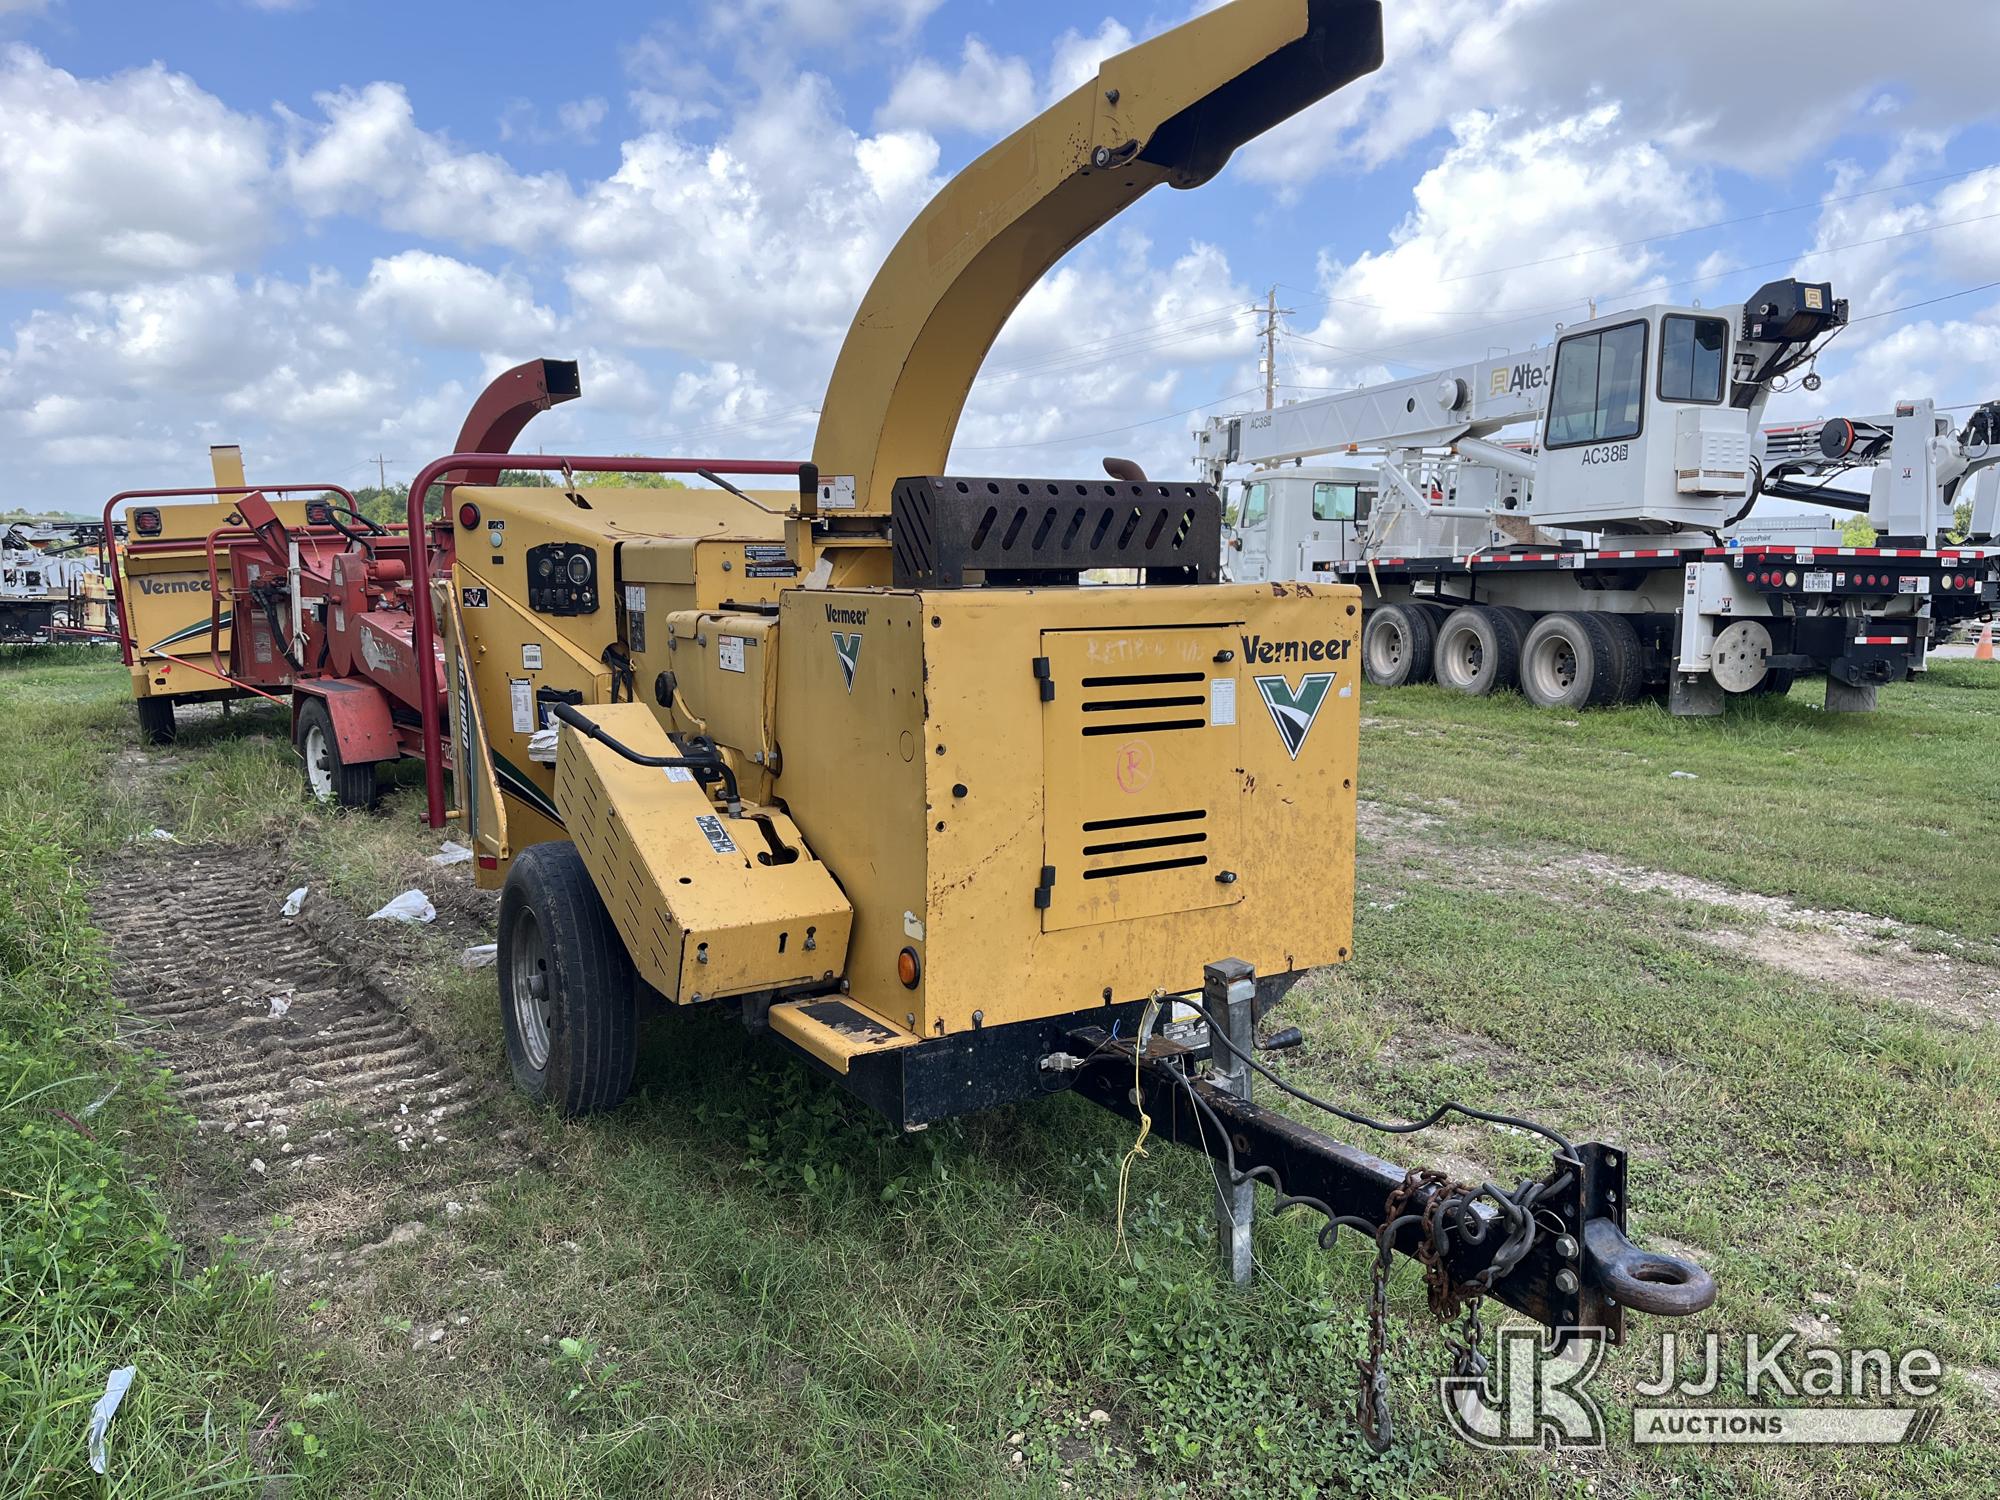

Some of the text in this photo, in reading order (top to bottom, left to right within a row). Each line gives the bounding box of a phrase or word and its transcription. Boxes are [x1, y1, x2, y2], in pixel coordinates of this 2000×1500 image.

[139, 579, 211, 595] Vermee
[825, 604, 867, 625] Vermeer
[1241, 635, 1351, 664] Vermeer
